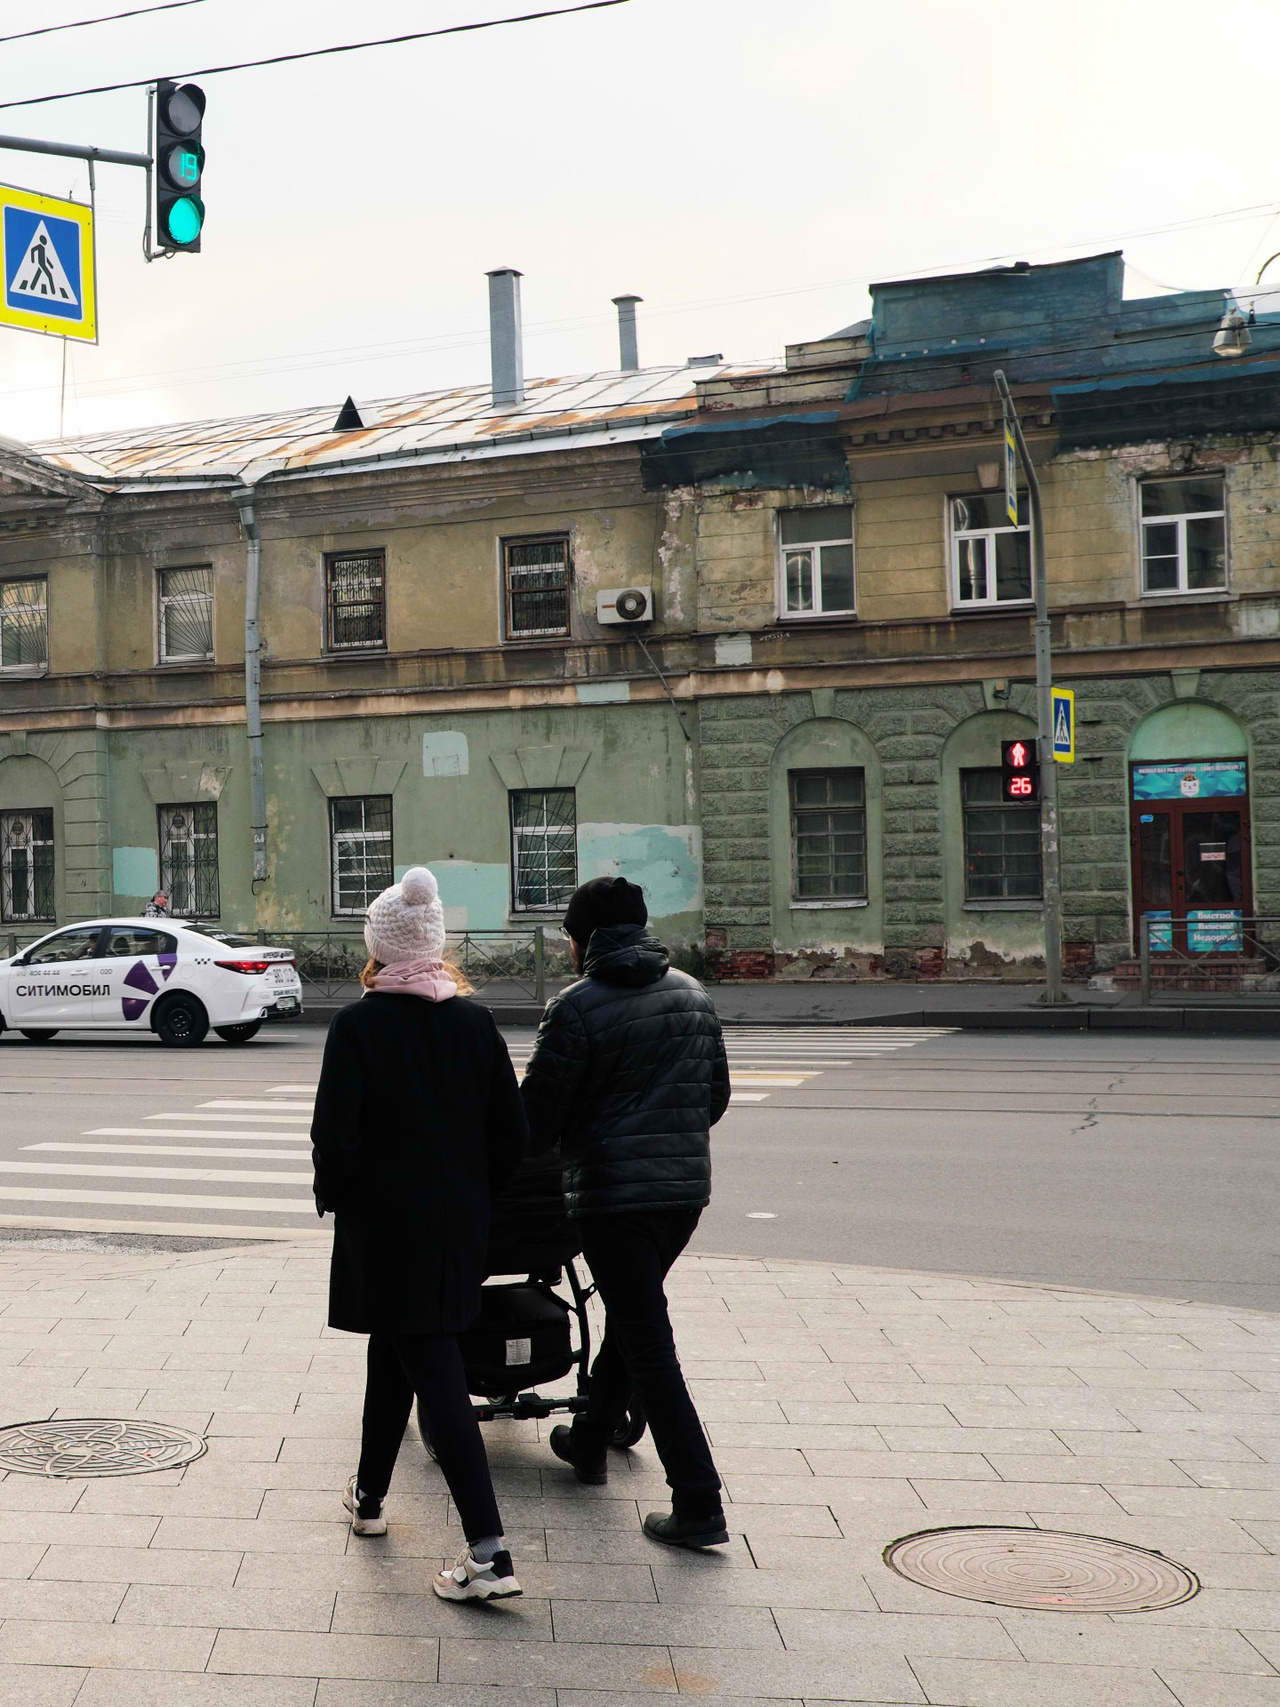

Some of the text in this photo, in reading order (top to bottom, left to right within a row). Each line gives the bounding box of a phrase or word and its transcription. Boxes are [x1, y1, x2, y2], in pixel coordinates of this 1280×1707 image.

[181, 152, 197, 180] 19
[1010, 777, 1032, 794] 26
[1193, 933, 1238, 942] Недороо!
[16, 984, 111, 997] СИТИМОБИЛ
